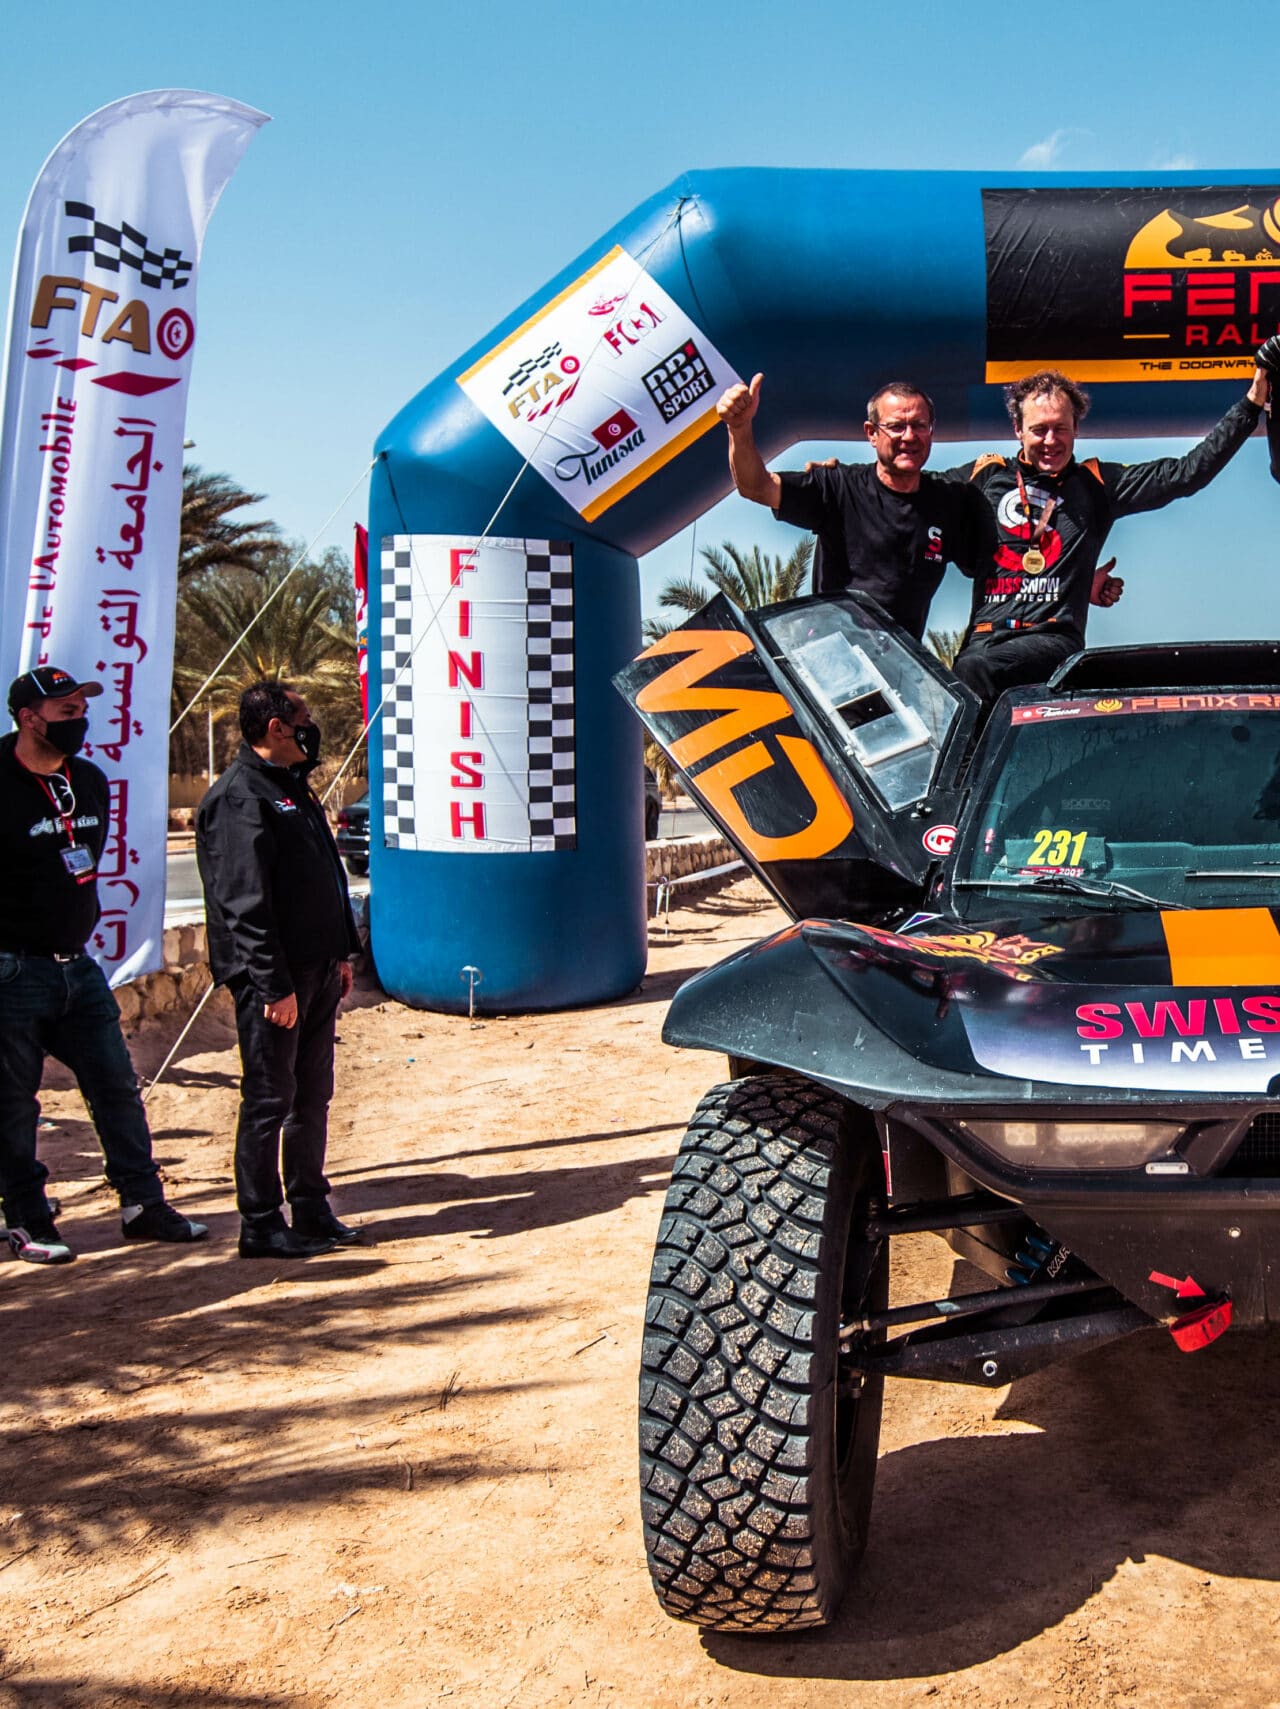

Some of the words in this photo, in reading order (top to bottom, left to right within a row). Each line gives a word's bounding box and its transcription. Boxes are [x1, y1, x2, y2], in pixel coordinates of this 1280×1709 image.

[30, 274, 152, 355] FTA
[1140, 361, 1172, 371] THE
[507, 371, 564, 419] FTA
[663, 372, 711, 419] SPORT
[554, 426, 647, 487] Tunisia
[96, 416, 164, 571] الجامعة
[84, 588, 148, 762] التونسية
[448, 547, 487, 840] FINISH
[1131, 695, 1238, 711] FENIX
[1027, 829, 1088, 866] 231
[1080, 1037, 1268, 1065] TIME
